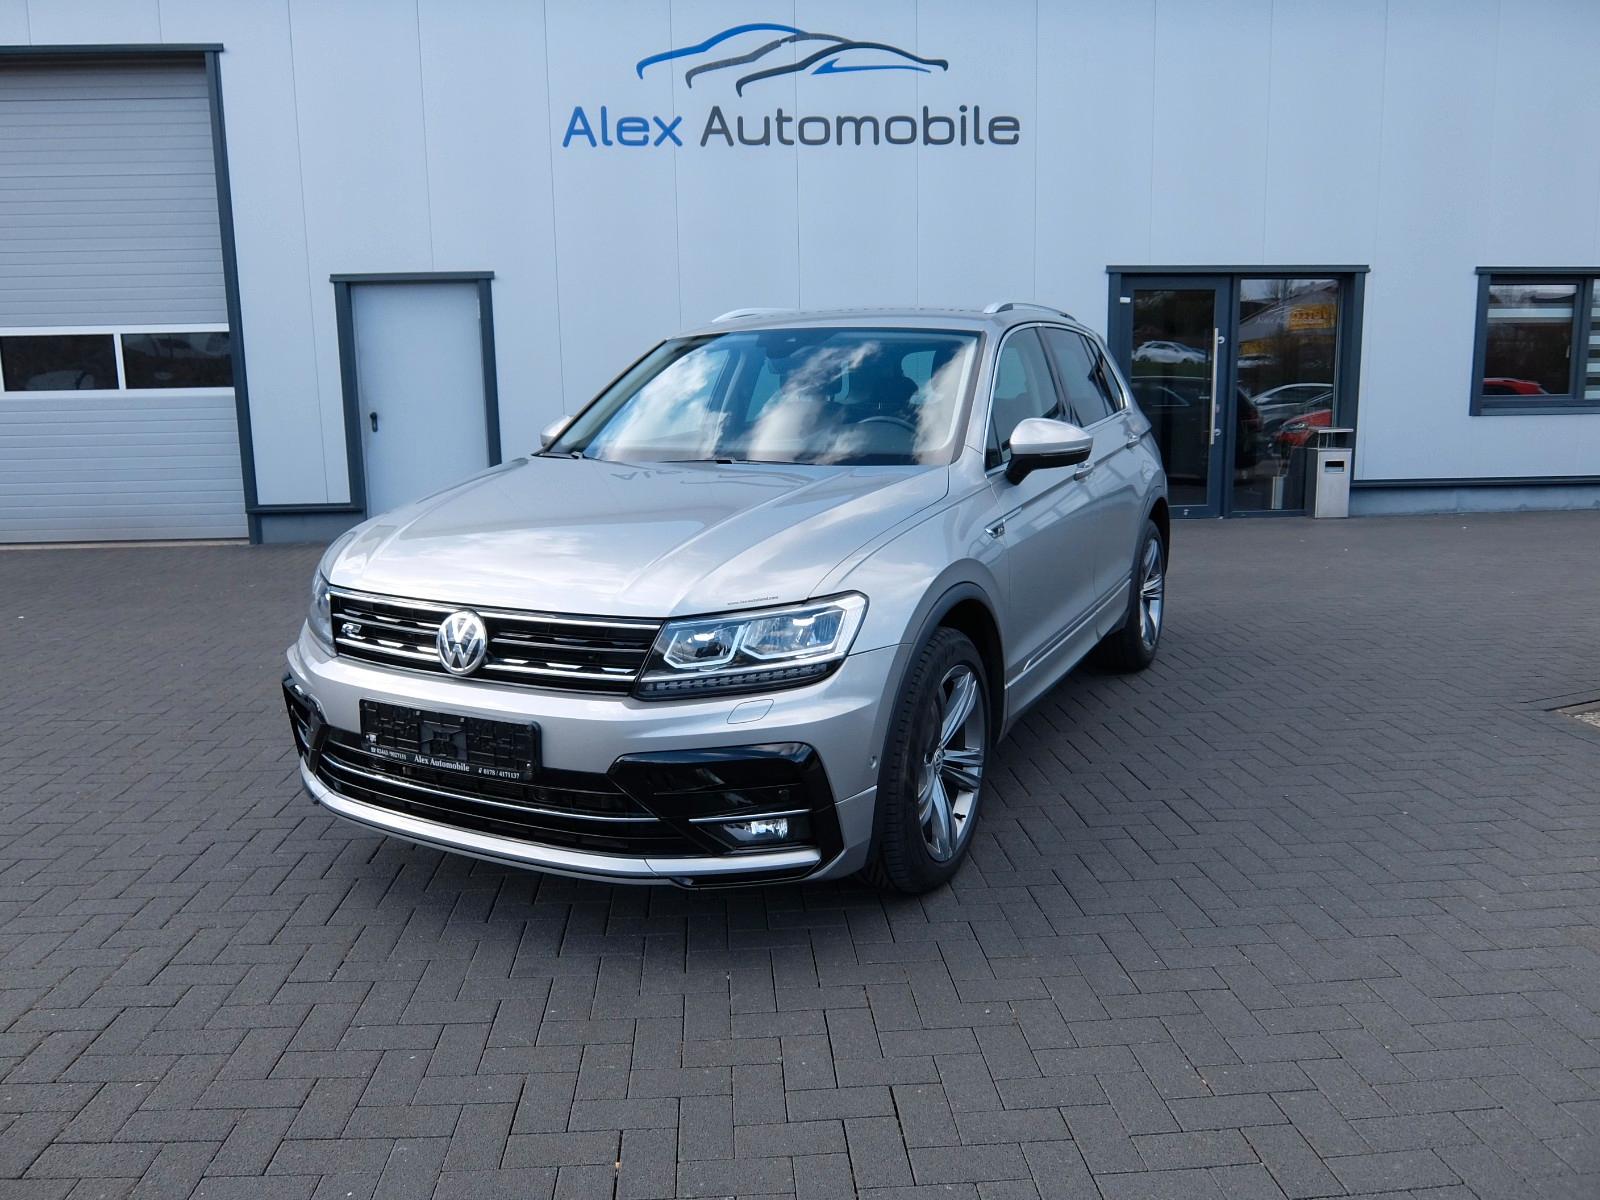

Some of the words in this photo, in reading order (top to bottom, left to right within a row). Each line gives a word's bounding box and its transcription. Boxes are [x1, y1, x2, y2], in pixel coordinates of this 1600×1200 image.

[562, 105, 683, 147] Alex
[700, 105, 1020, 147] Automobile
[438, 610, 486, 672] VW
[414, 754, 429, 766] Alex
[430, 757, 470, 772] Automobile
